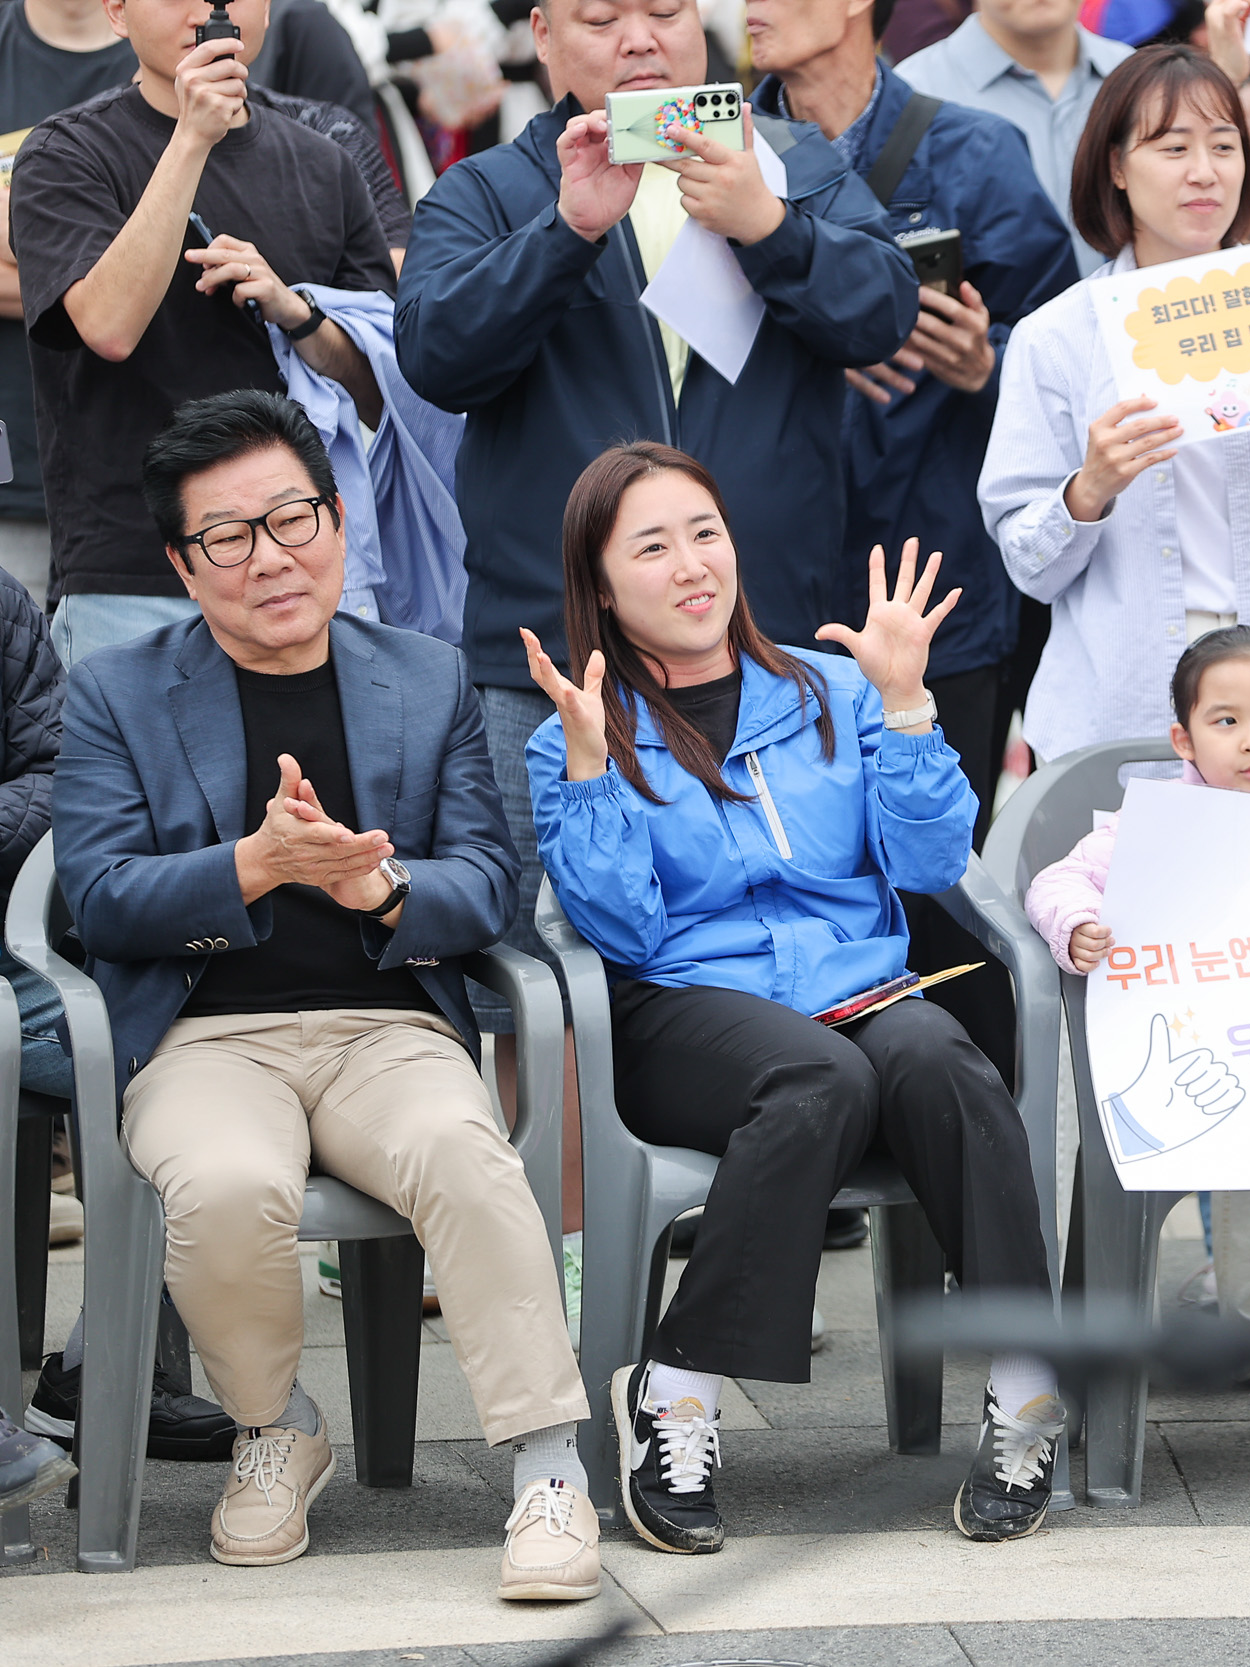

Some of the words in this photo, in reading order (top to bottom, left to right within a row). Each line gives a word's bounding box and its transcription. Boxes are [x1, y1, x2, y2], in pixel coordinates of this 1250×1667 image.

[1150, 294, 1217, 325] 최고다!
[1178, 333, 1217, 357] 우리
[1222, 327, 1243, 348] 집
[1106, 942, 1181, 990] 우리
